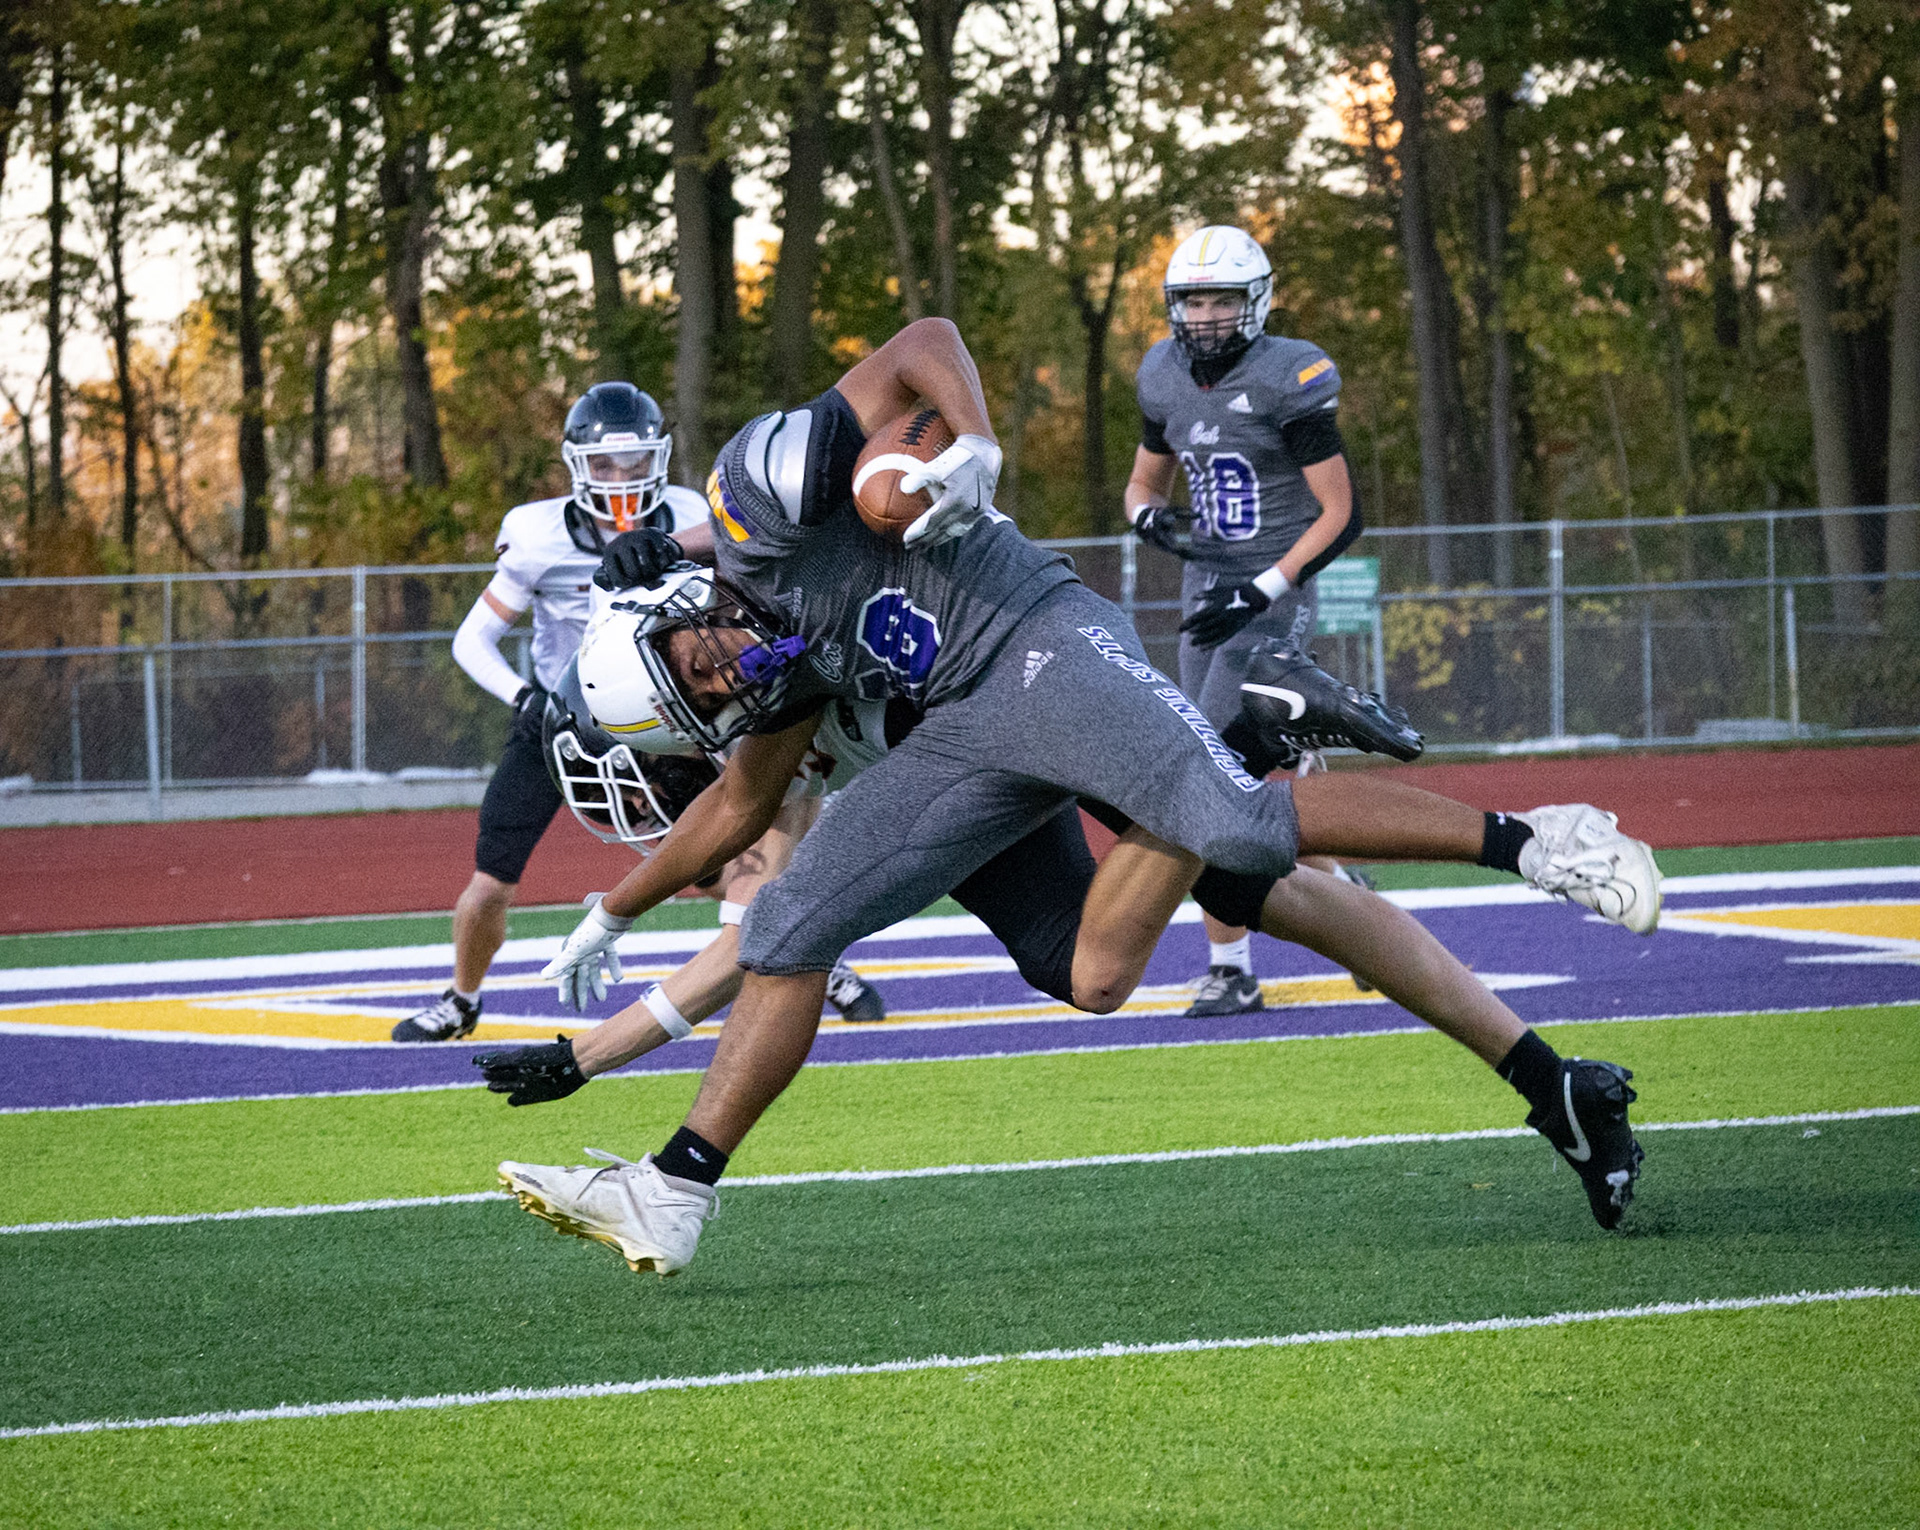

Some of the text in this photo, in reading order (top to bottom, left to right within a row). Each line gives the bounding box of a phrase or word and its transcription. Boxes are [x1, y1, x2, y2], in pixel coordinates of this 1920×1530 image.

[1022, 650, 1055, 688] adidas
[1076, 625, 1263, 792] FIGHTING SCOTS
